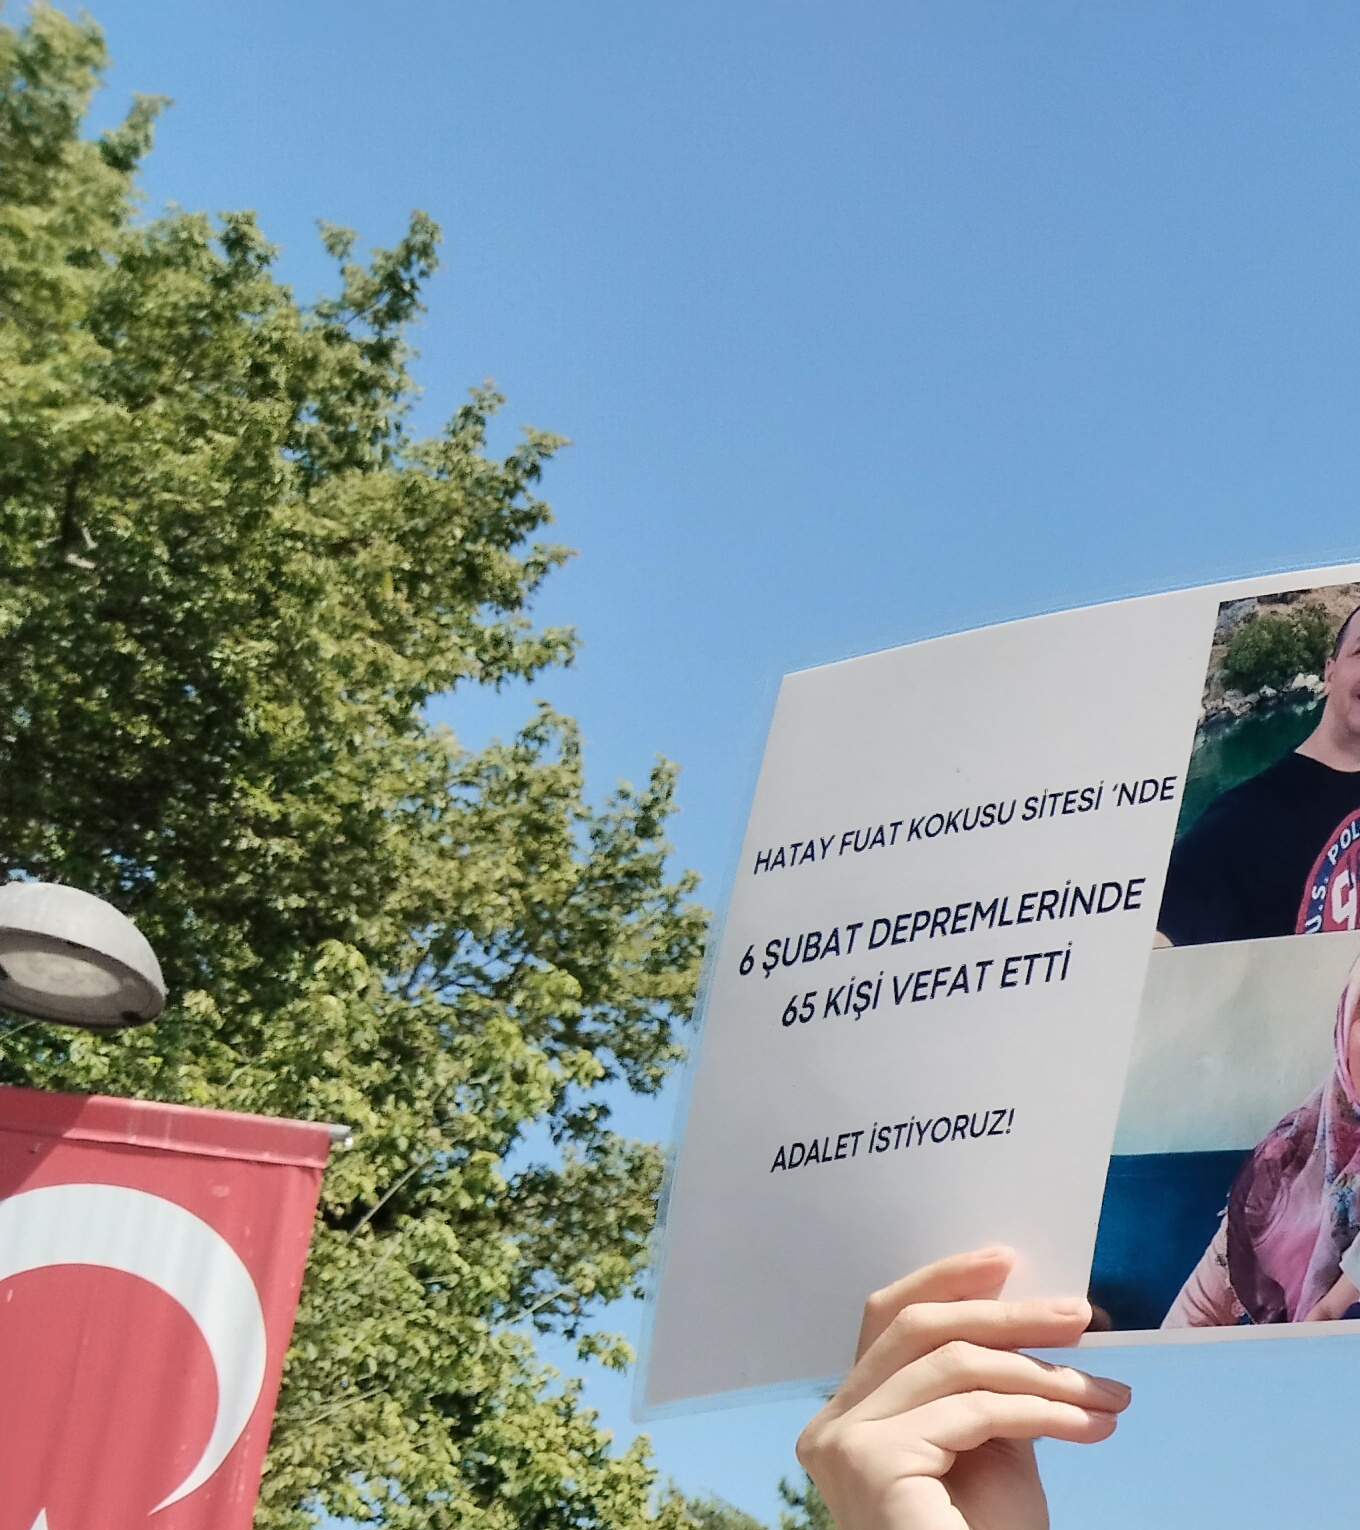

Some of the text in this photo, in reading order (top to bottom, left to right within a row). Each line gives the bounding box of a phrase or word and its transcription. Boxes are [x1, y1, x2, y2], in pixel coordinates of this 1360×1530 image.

[754, 835, 834, 874] HATAY
[838, 821, 903, 856] FUAT
[907, 799, 1016, 842] KOKUSU
[1022, 781, 1104, 821] SİTESİ
[739, 878, 1147, 979] 6 ŞUBAT DEPREMLERİNDE
[781, 941, 1074, 1027] 65 KİŞİ VEFAT ETTİ
[770, 1108, 1015, 1173] ADALET İSTİYORUZ!
